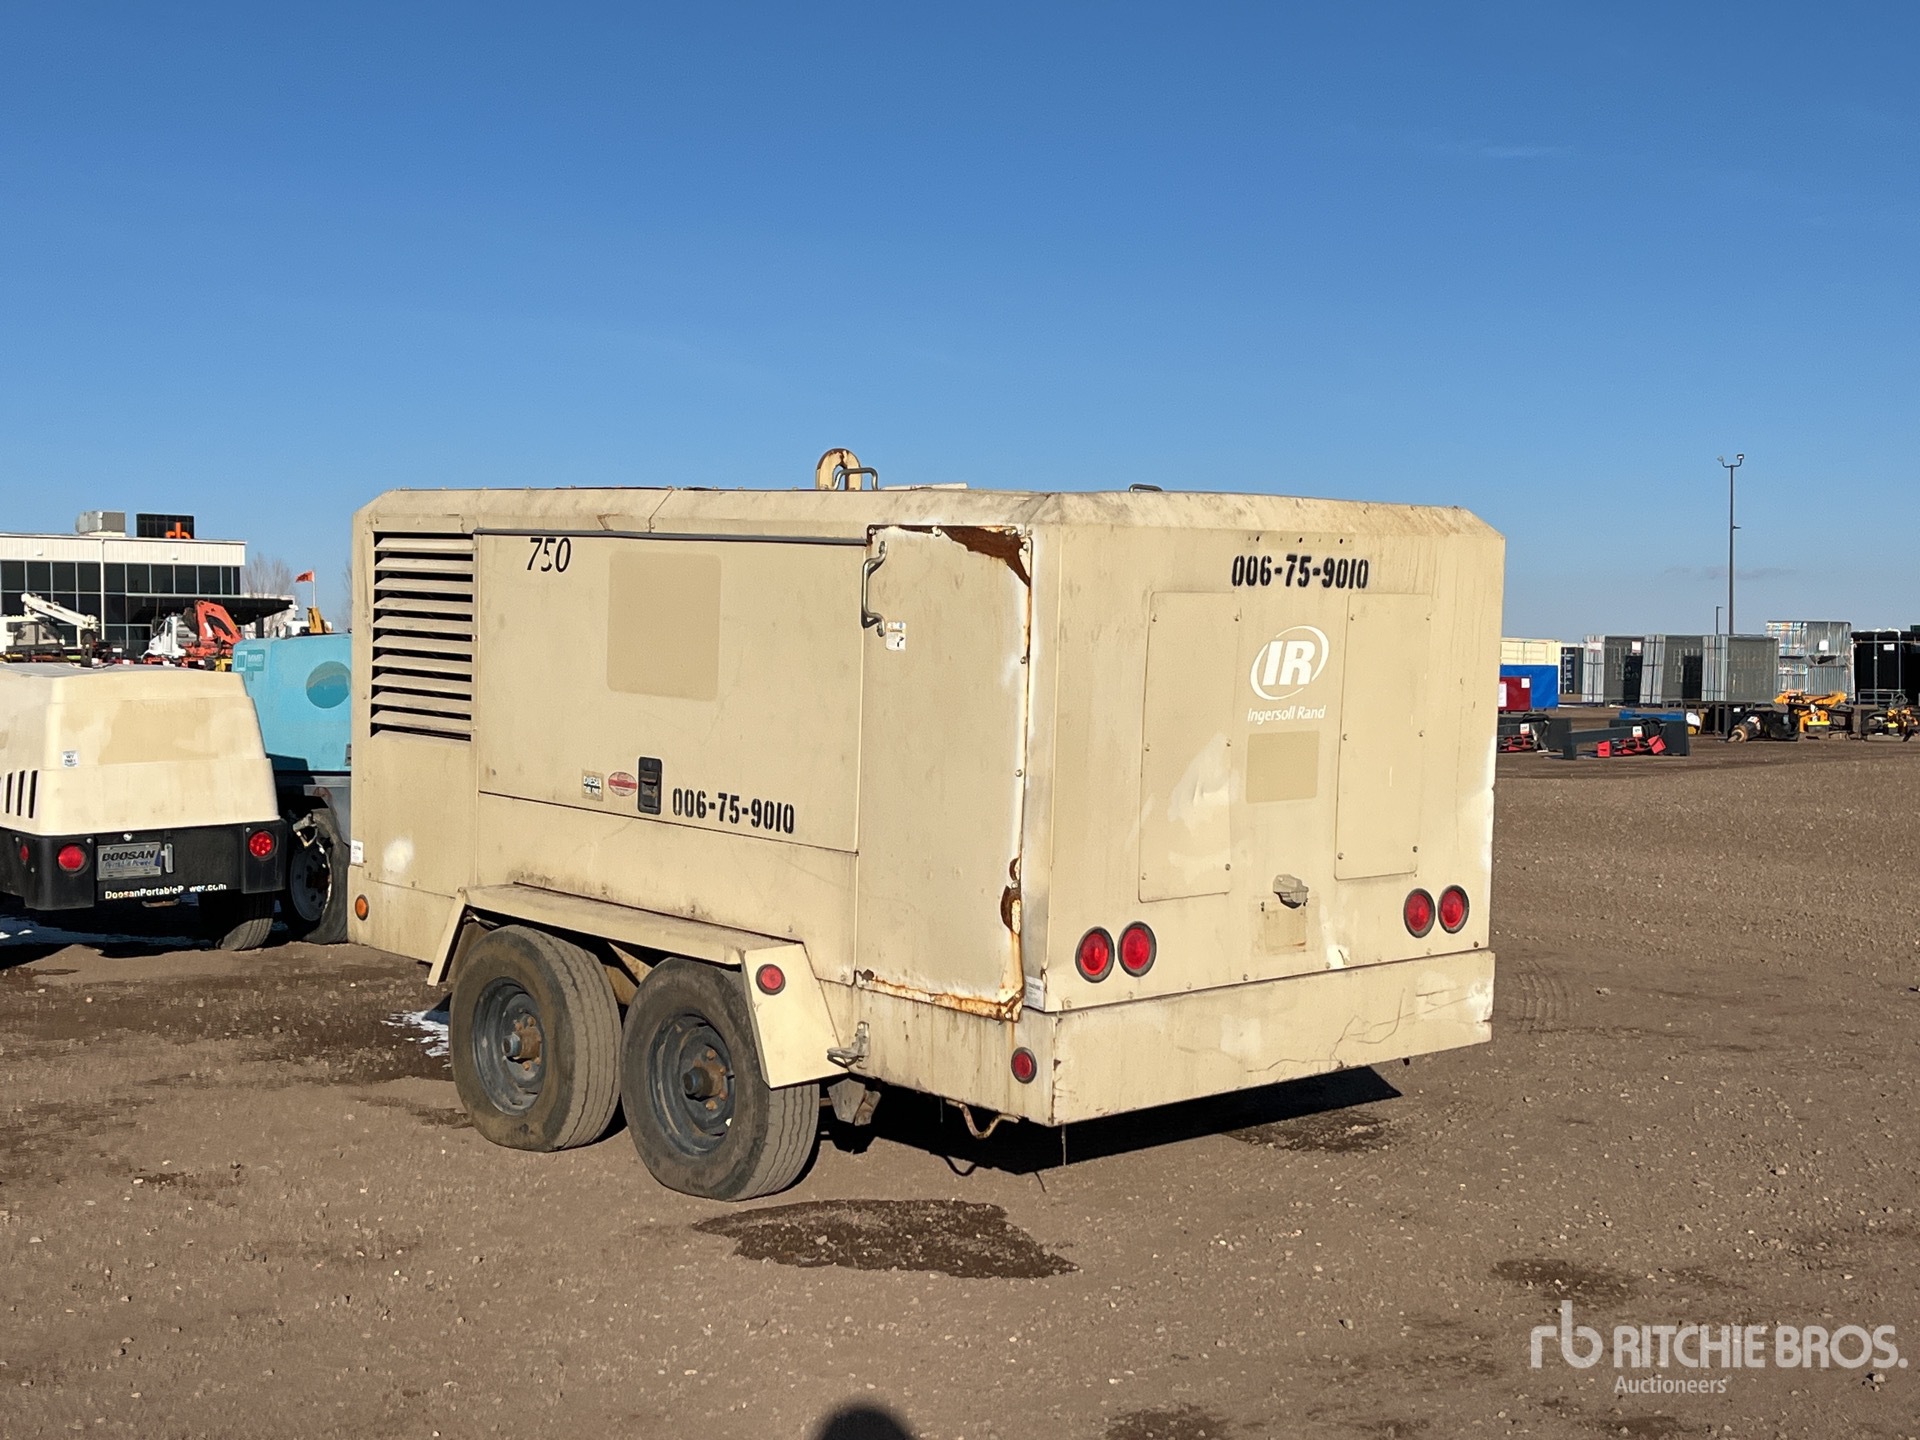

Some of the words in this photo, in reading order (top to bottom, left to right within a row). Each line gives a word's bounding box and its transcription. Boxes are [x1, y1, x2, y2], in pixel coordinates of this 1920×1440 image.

[526, 537, 572, 573] 750
[1231, 554, 1370, 589] 006-75-9010
[1262, 640, 1316, 687] IR
[1247, 705, 1295, 725] Ingersoll
[1297, 704, 1326, 721] Rand
[672, 788, 795, 834] 006-75-9010
[102, 850, 155, 862] DOOSAN
